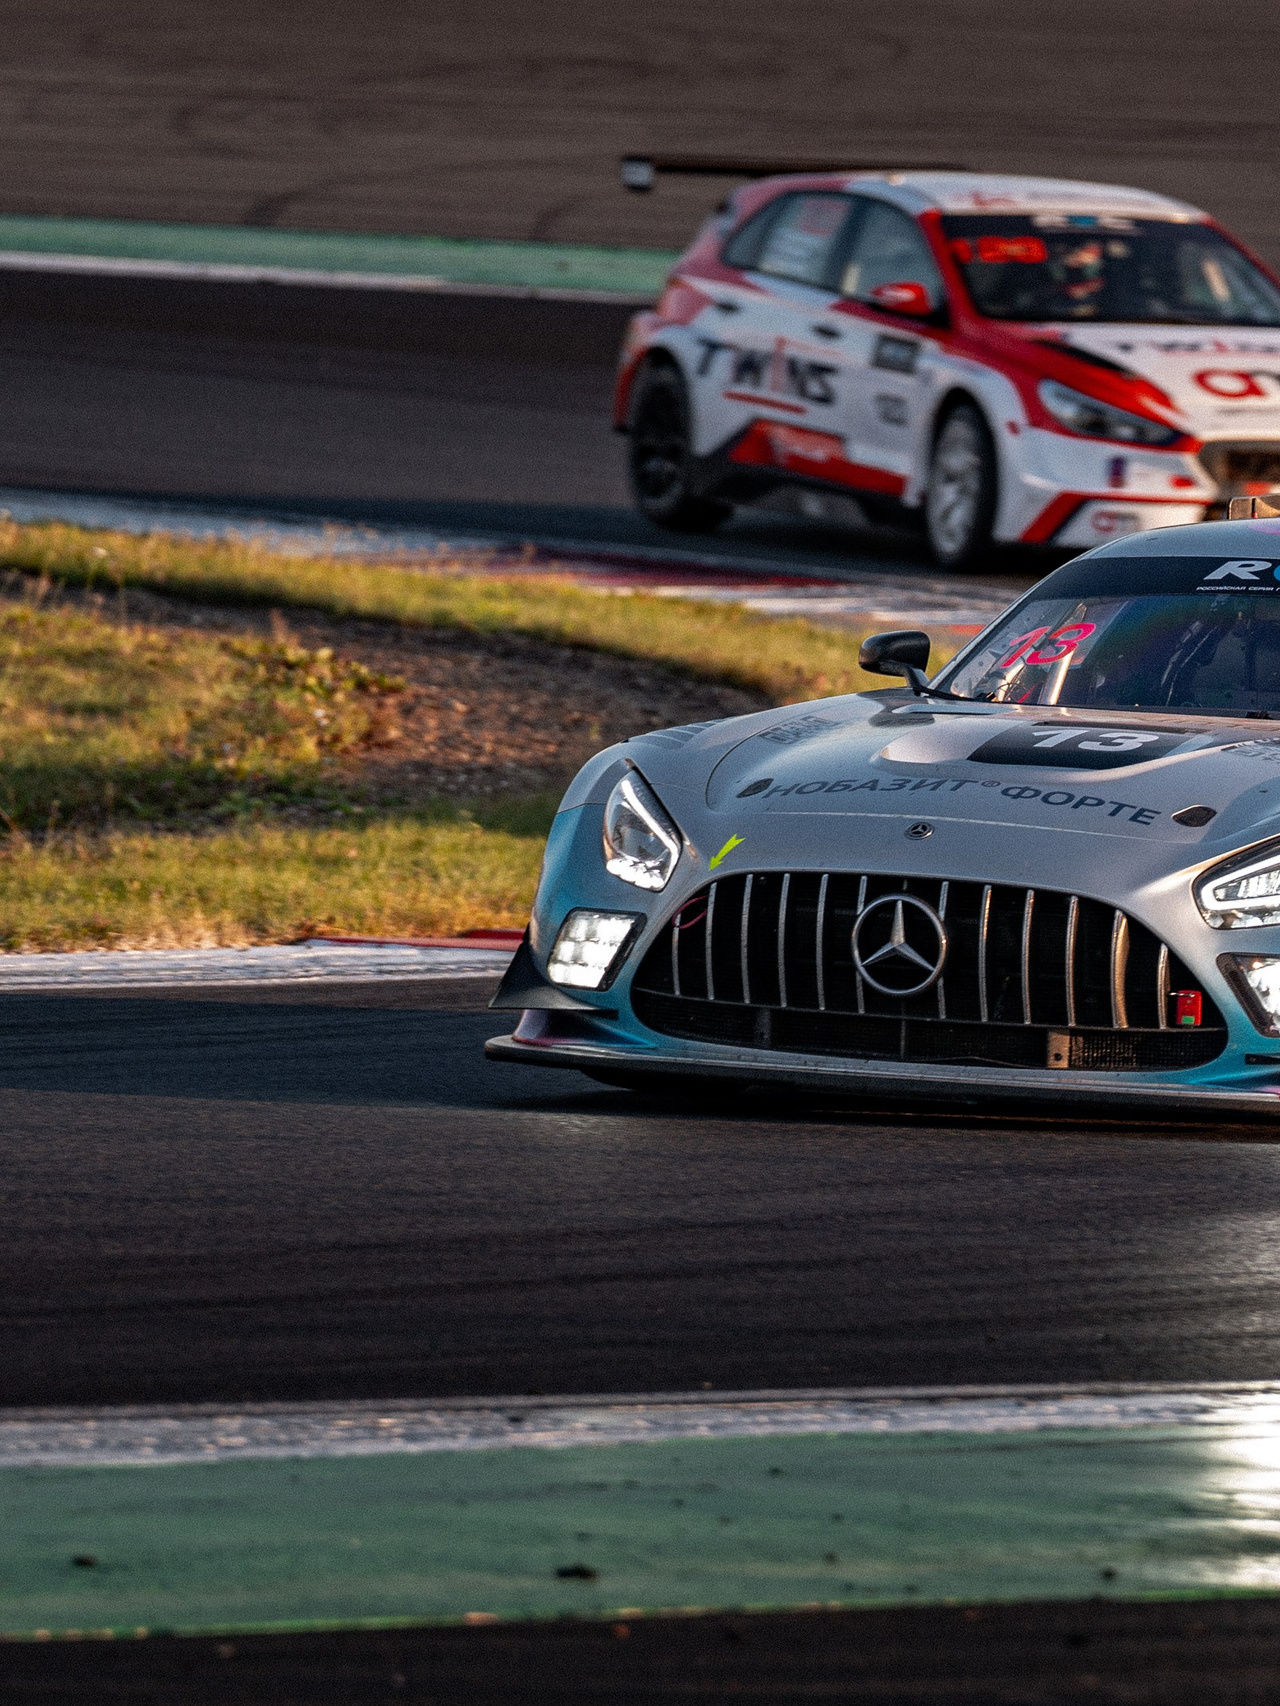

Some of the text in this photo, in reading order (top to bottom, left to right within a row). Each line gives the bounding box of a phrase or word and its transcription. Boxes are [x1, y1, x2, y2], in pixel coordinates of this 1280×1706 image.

[698, 336, 838, 407] TWINS
[1001, 623, 1096, 667] 13
[1031, 729, 1160, 752] 13
[1001, 785, 1161, 826] ФОРТЕ
